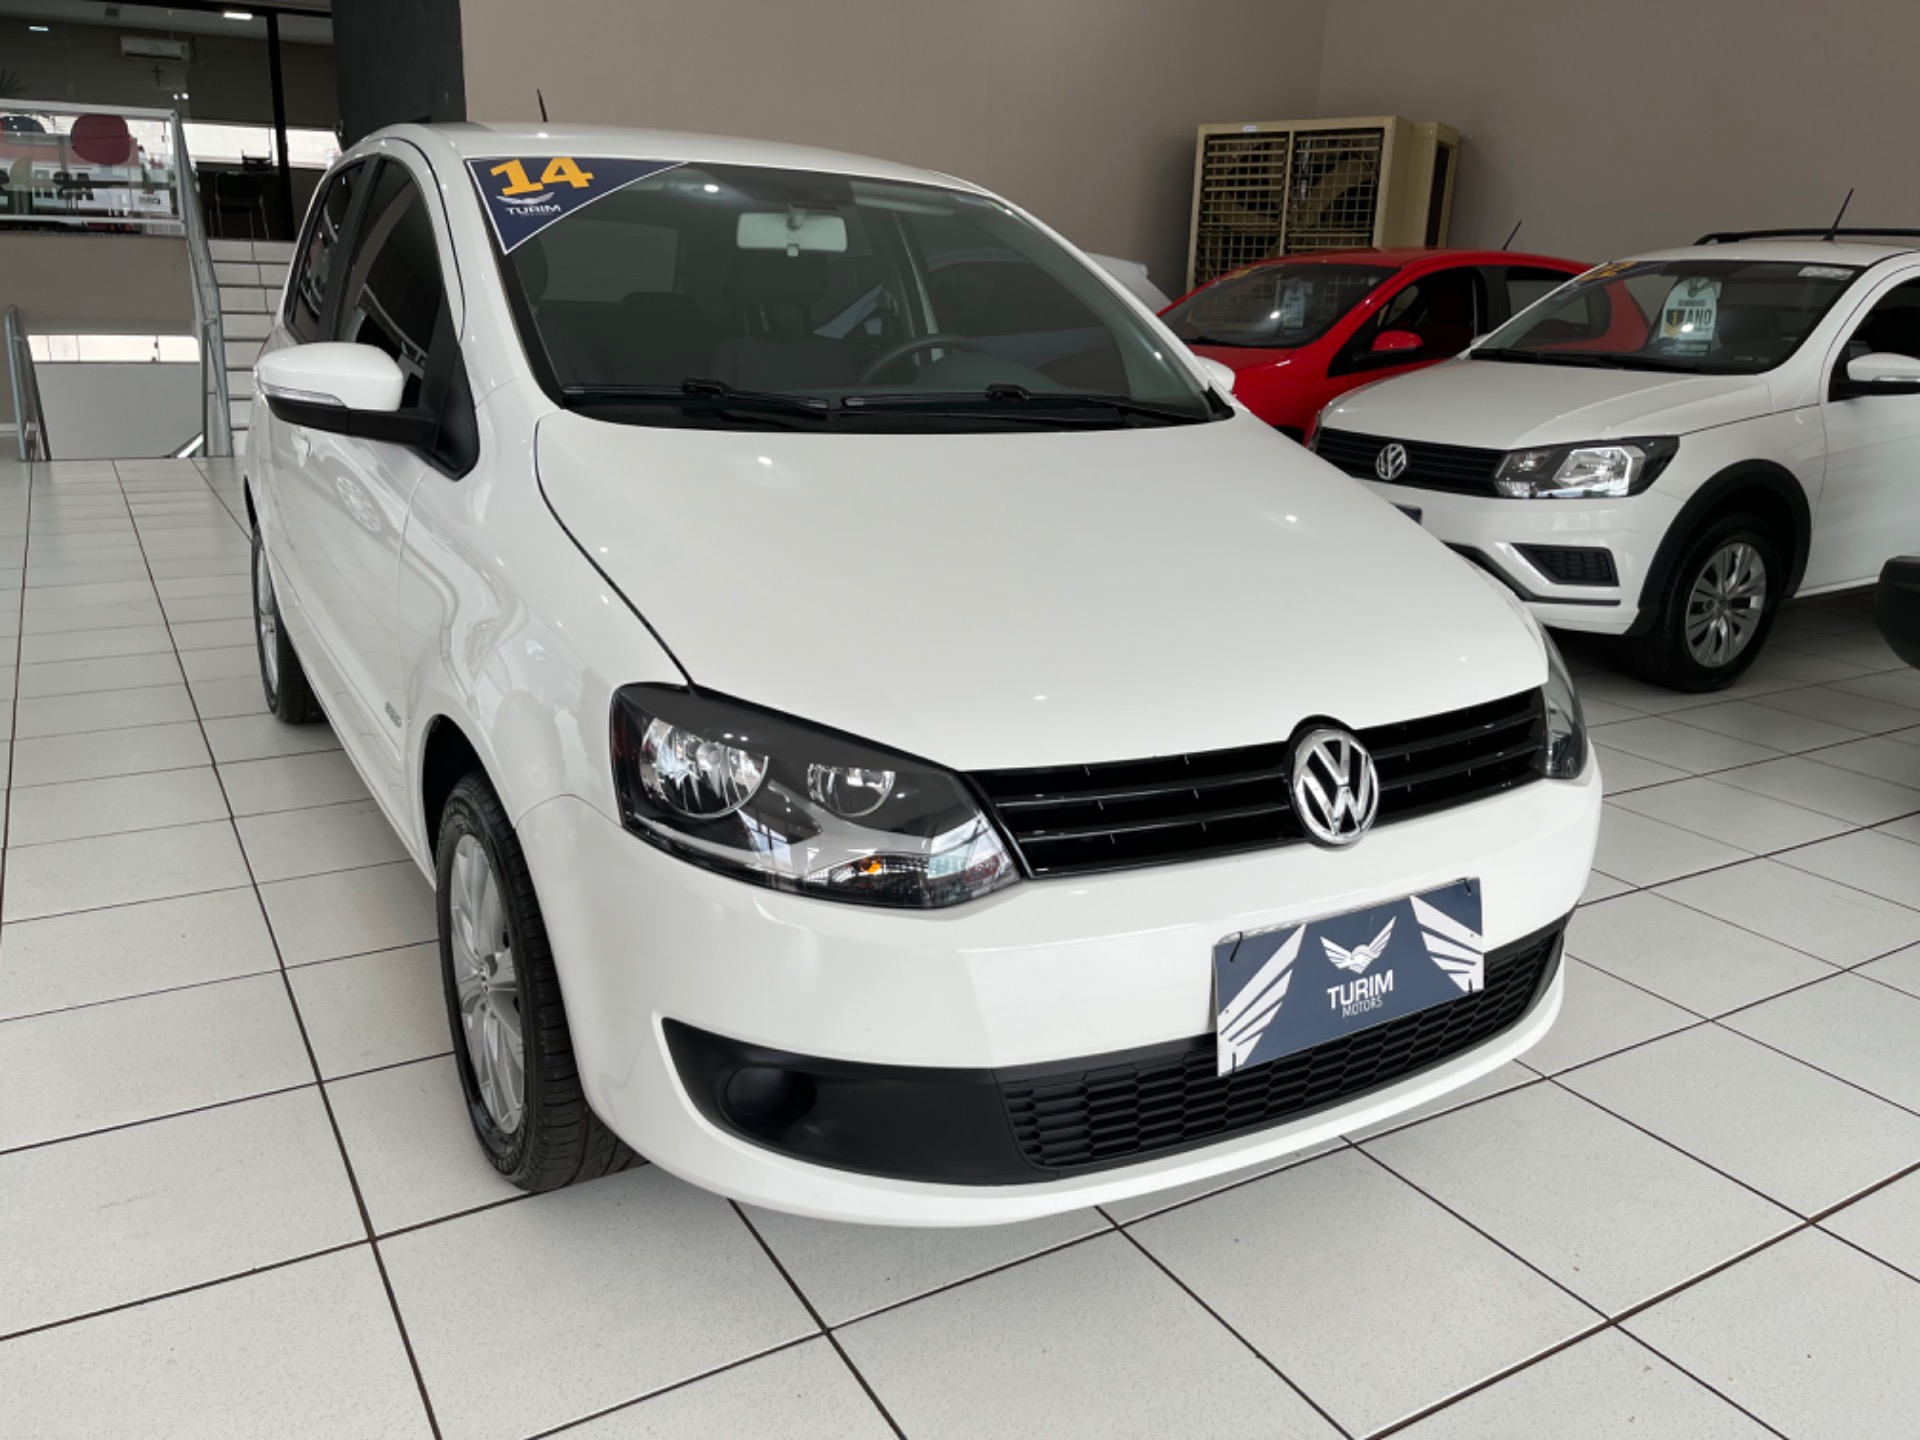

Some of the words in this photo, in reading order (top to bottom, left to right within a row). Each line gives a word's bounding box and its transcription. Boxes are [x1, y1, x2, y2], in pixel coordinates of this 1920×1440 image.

[489, 157, 595, 196] 14
[504, 204, 562, 215] TURIM
[1295, 731, 1377, 843] VW
[1327, 969, 1393, 1010] TURIM
[1342, 995, 1383, 1018] MOTORS
